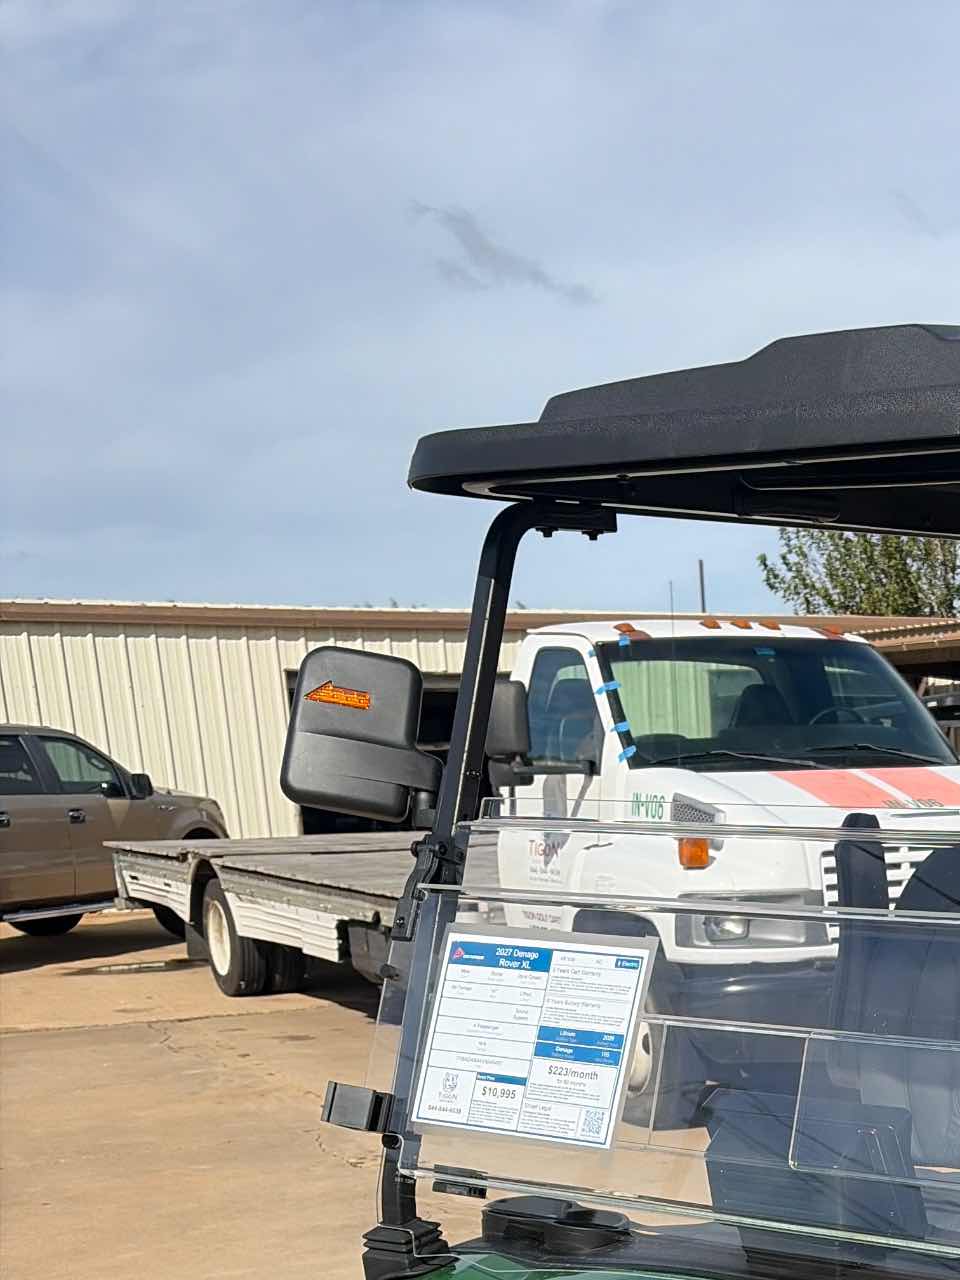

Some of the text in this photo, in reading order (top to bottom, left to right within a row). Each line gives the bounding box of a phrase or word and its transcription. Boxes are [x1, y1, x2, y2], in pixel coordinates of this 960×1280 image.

[631, 792, 665, 820] IN-V06
[529, 839, 561, 858] TIGON
[496, 947, 514, 957] 2027
[513, 948, 539, 960] Denago
[498, 958, 533, 969] Rover XL
[547, 1064, 600, 1081] $223/month
[481, 1085, 517, 1100] $10,995
